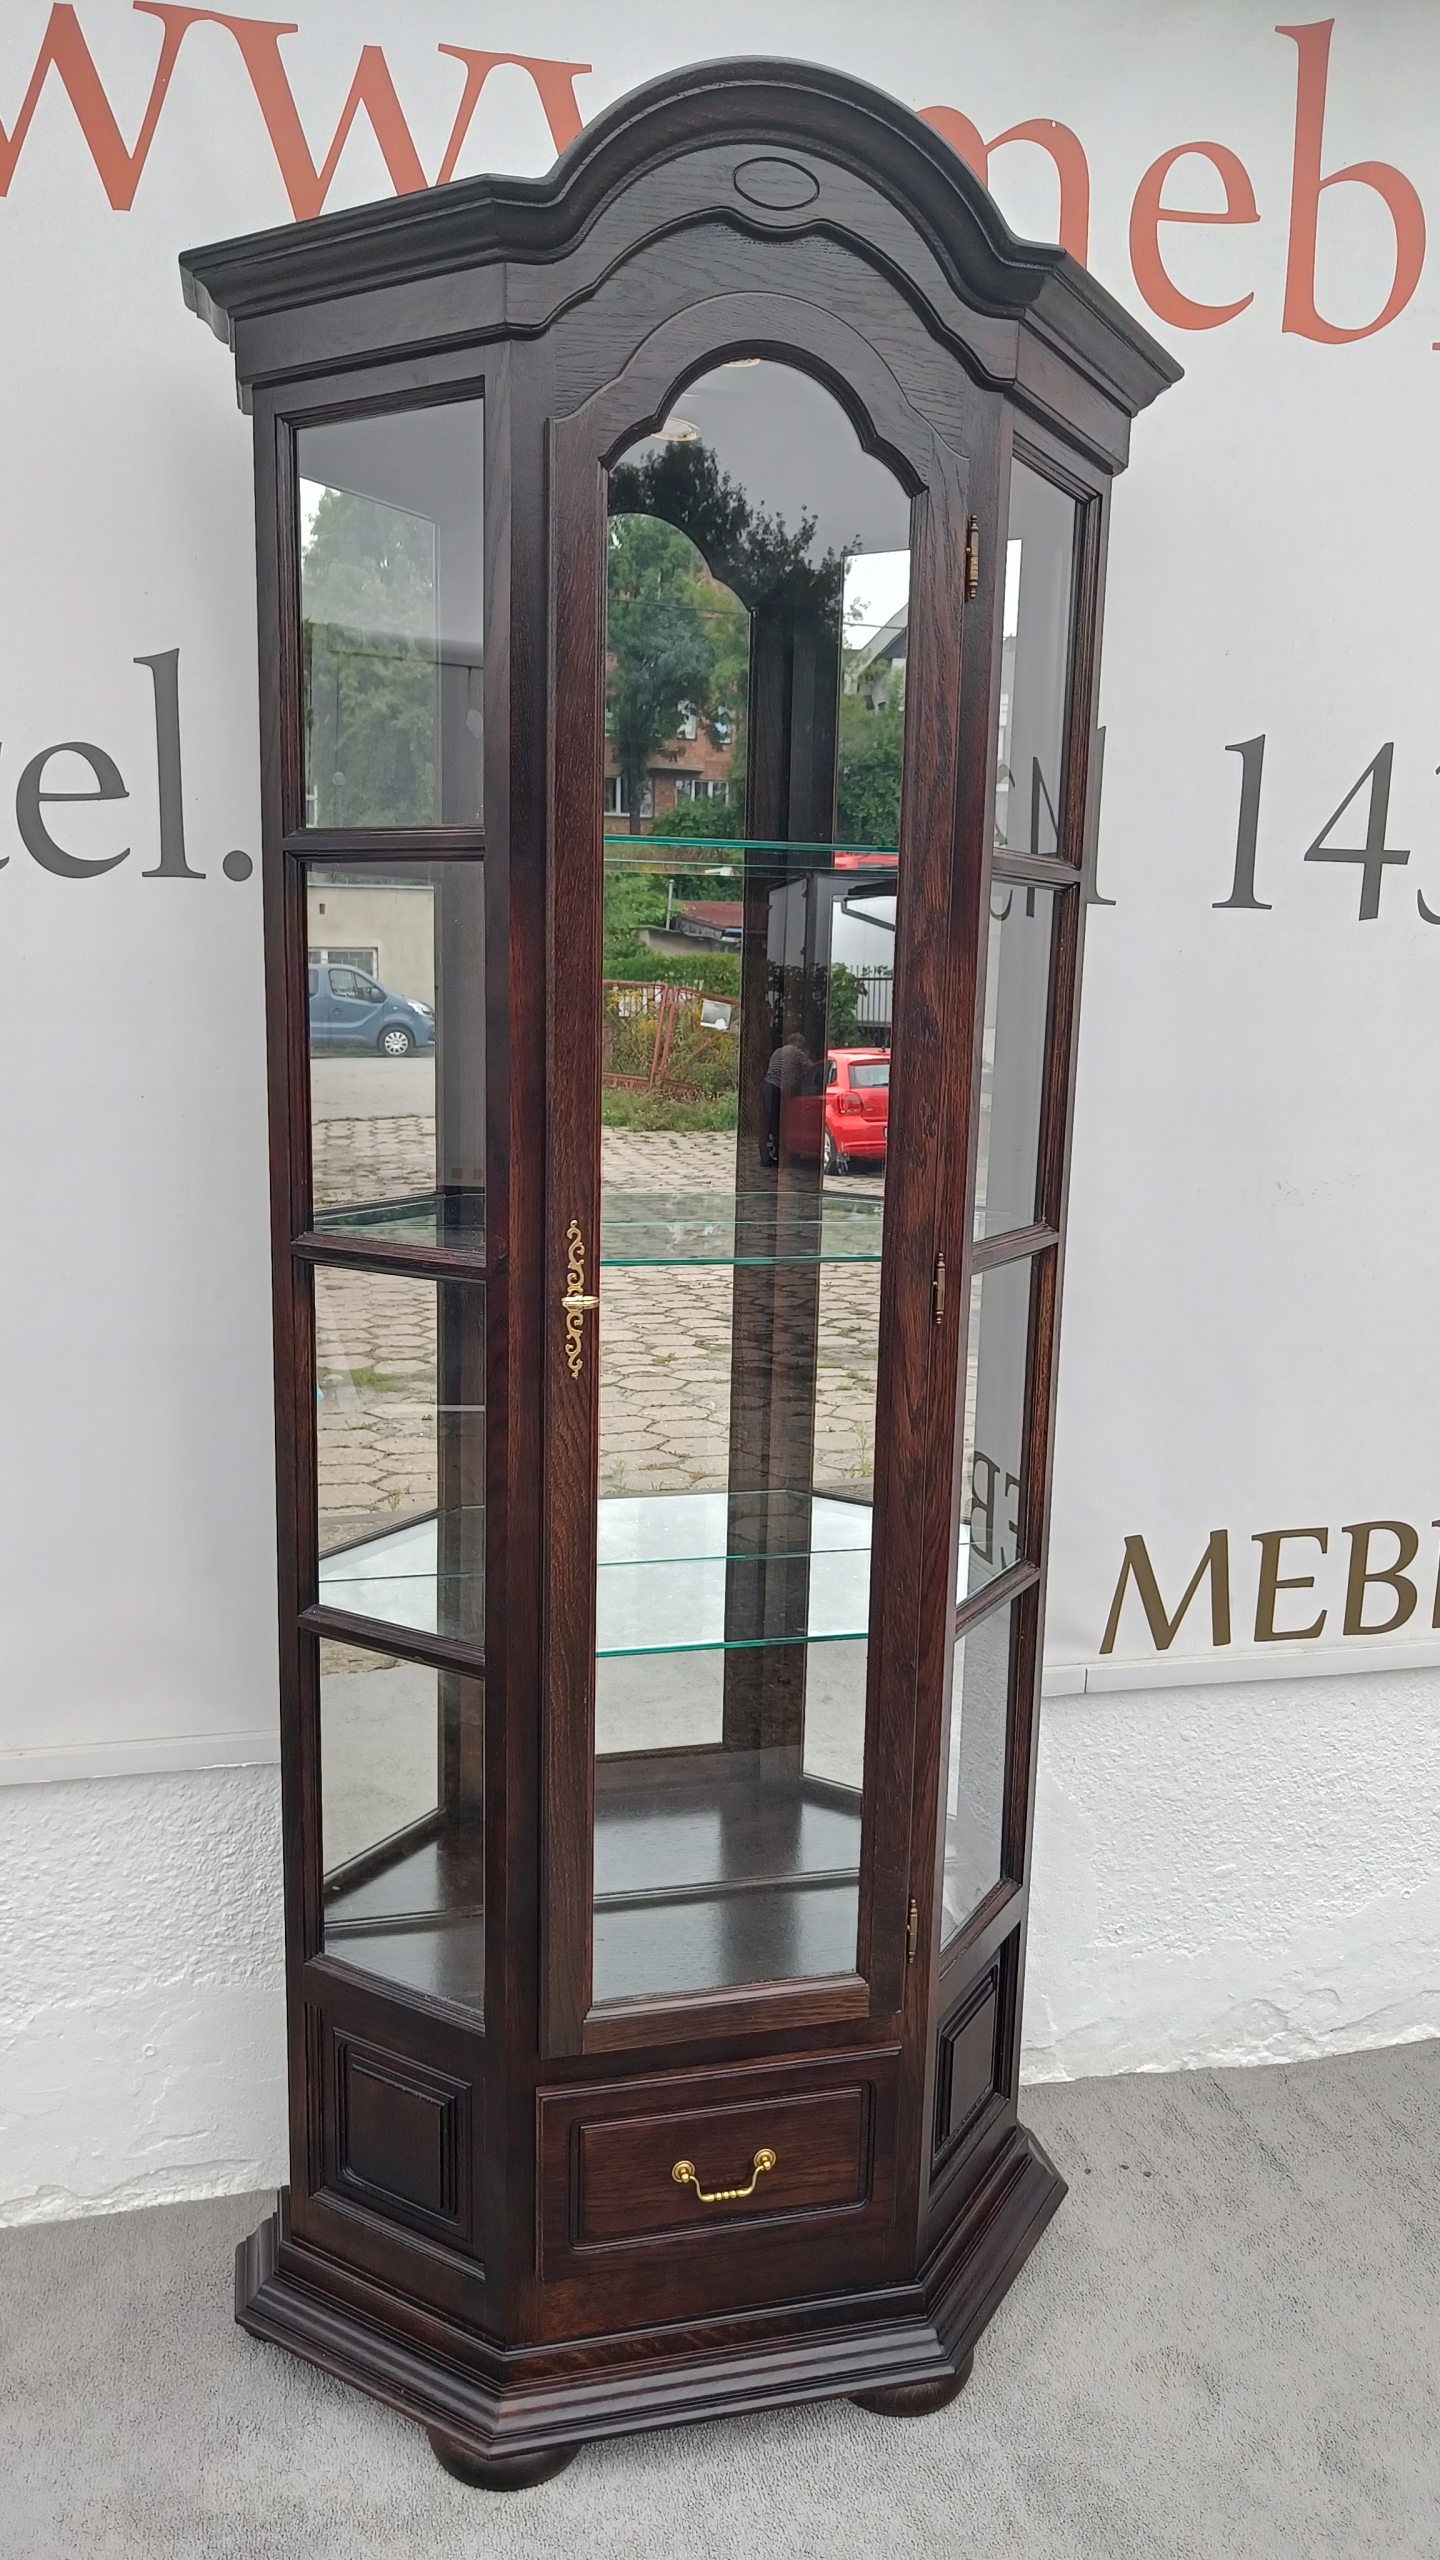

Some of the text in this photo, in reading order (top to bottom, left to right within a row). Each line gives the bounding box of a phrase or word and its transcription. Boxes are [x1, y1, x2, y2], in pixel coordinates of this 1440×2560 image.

[0, 648, 253, 882] el.
[1211, 734, 1440, 926] 14
[1099, 1520, 1440, 1655] MEB
